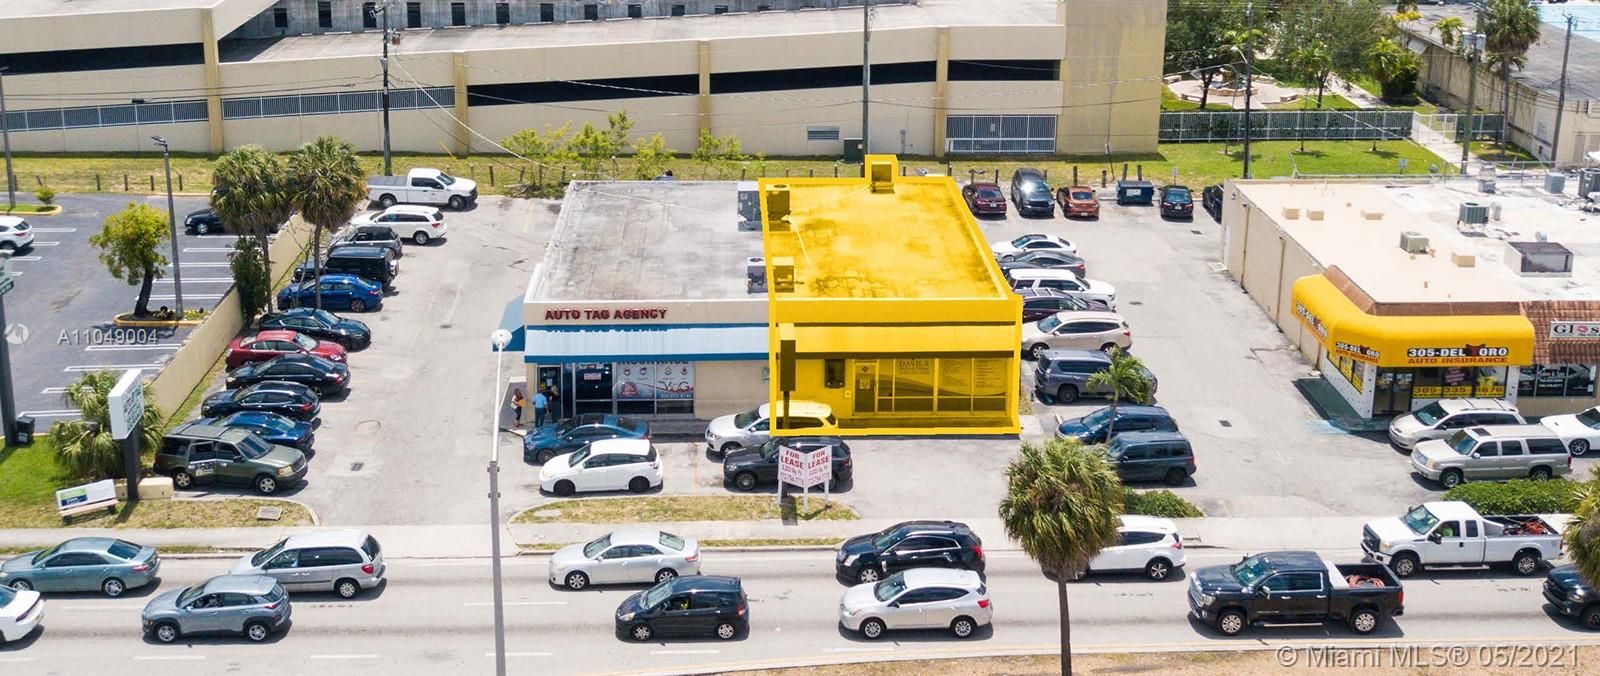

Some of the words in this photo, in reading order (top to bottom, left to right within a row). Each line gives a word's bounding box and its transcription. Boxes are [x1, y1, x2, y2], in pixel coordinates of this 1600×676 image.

[545, 308, 581, 320] AUTO
[585, 308, 610, 320] TAG
[614, 307, 667, 320] AGENCY
[1408, 347, 1466, 357] 305-DEL
[785, 450, 800, 460] FOR
[812, 450, 826, 460] FOR
[781, 456, 804, 469] LEASE
[808, 456, 830, 469] LEASE
